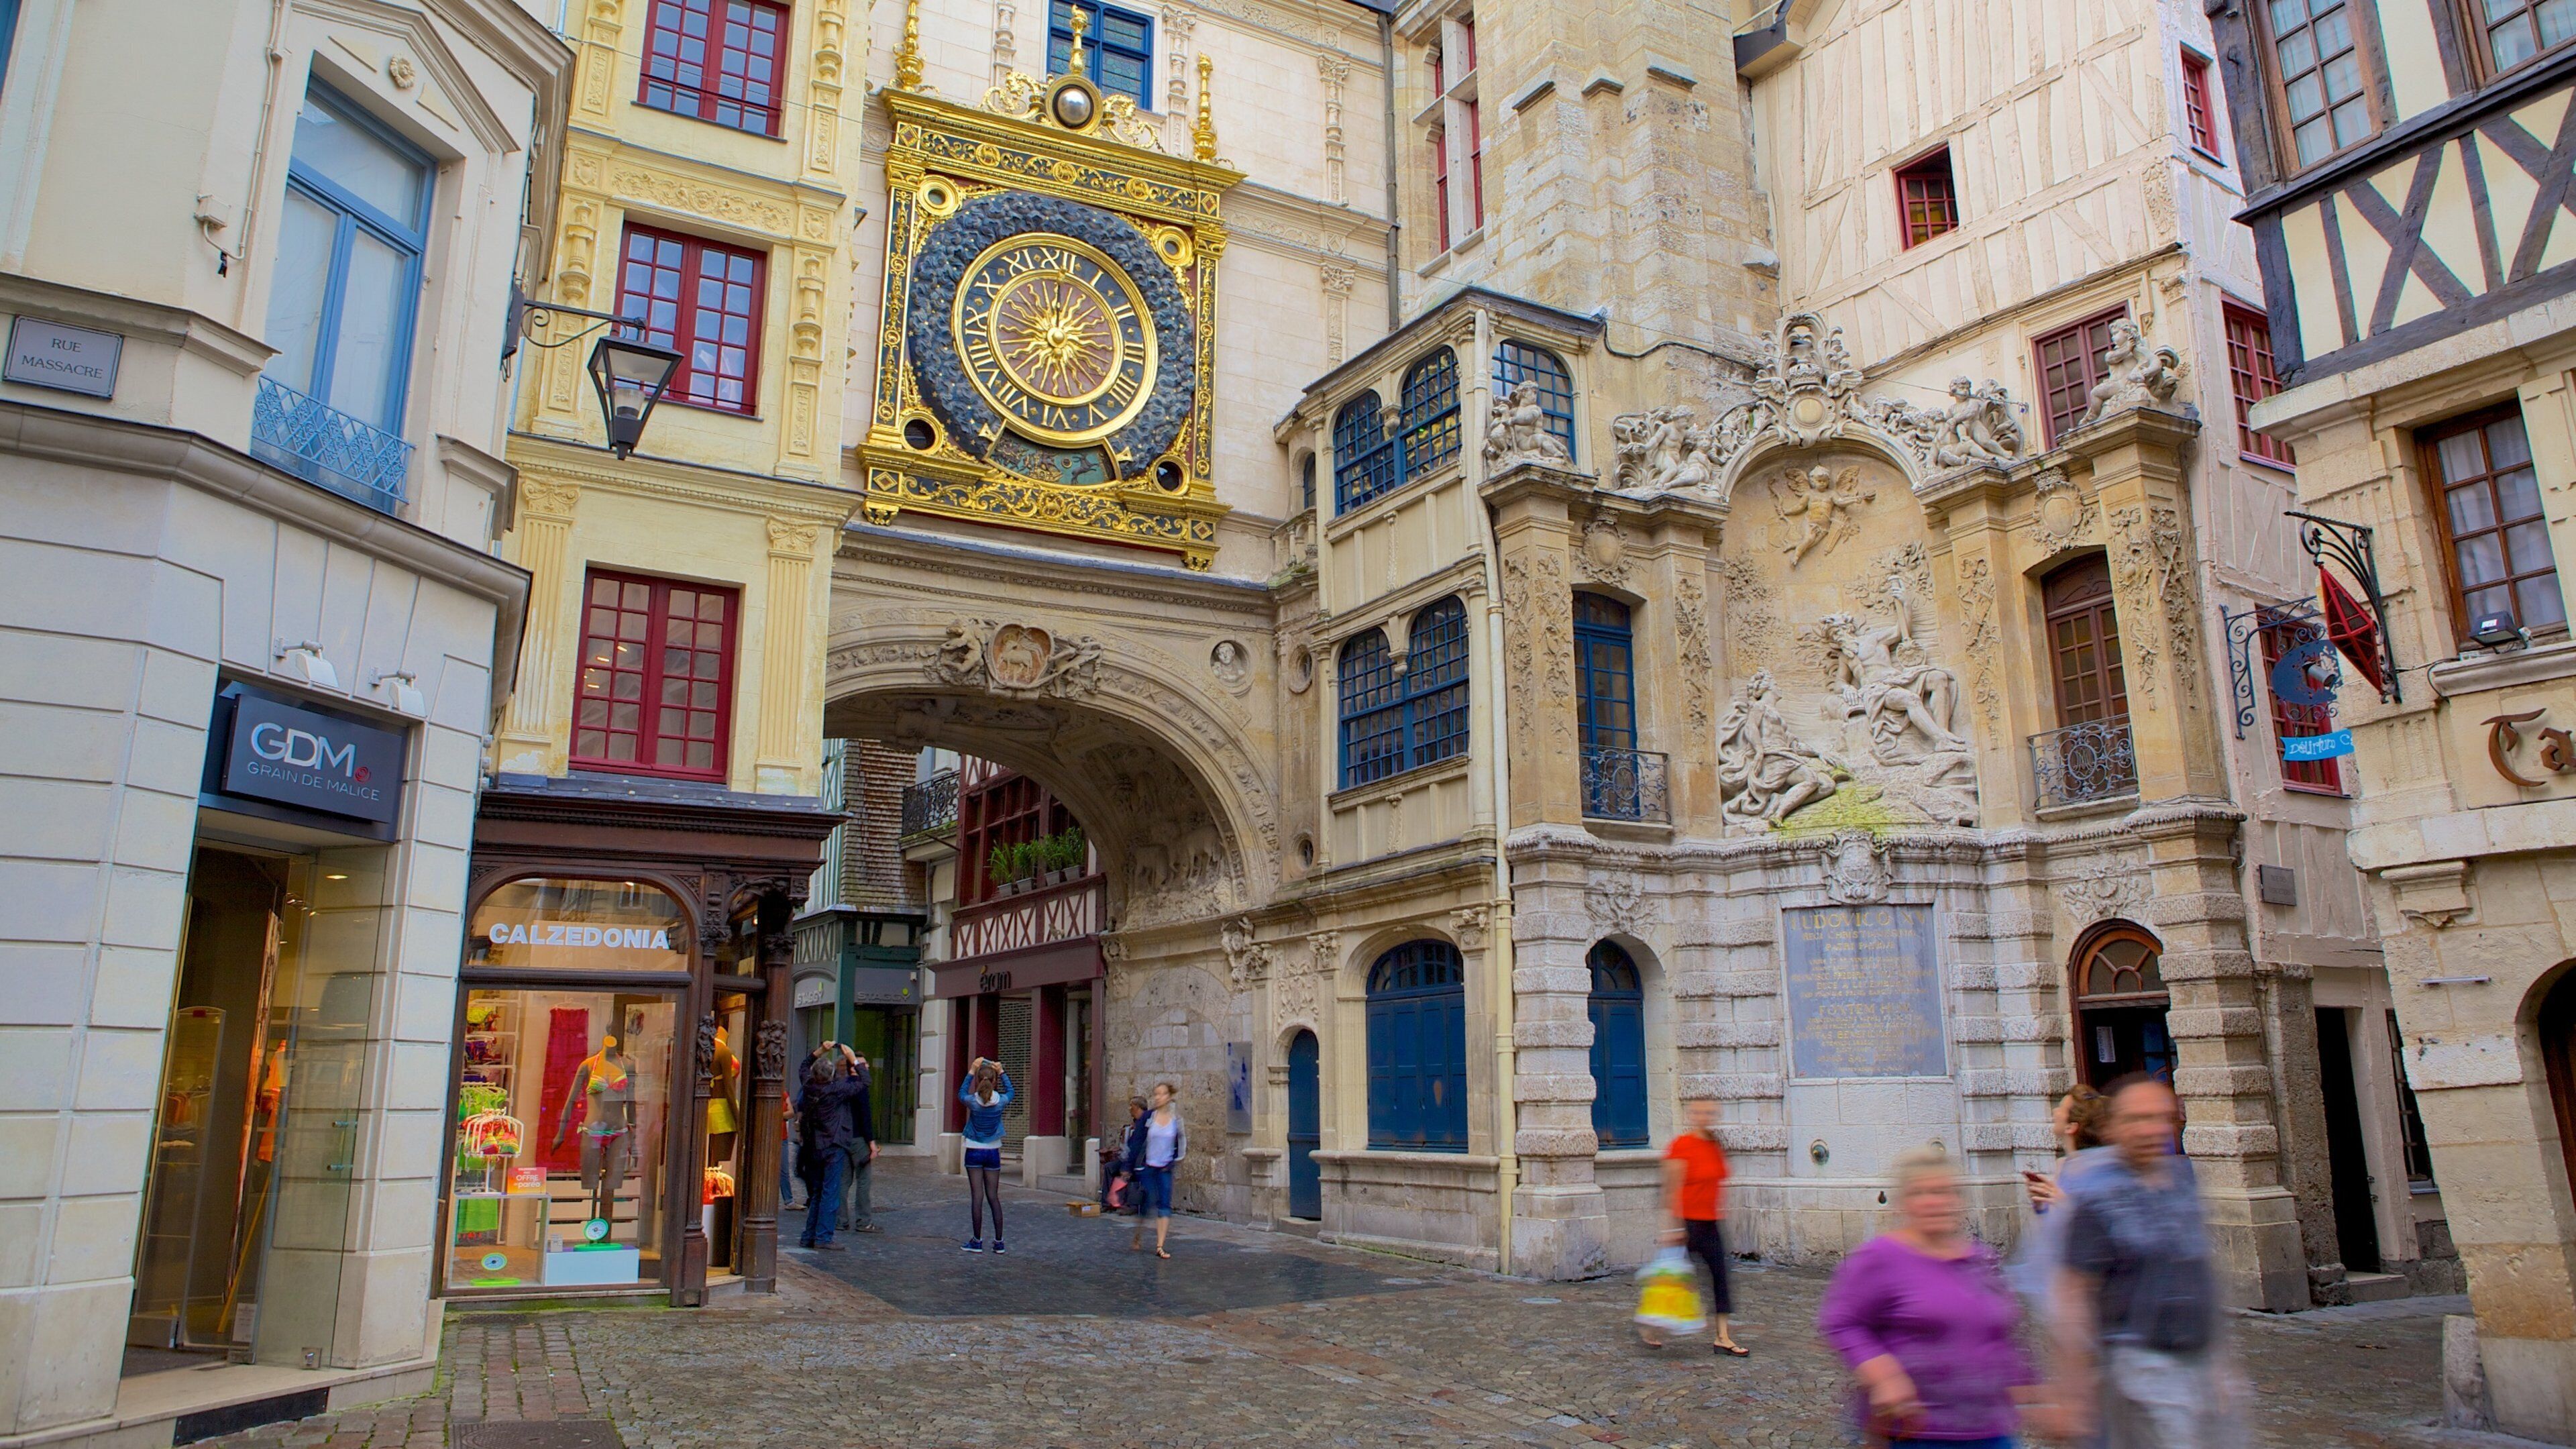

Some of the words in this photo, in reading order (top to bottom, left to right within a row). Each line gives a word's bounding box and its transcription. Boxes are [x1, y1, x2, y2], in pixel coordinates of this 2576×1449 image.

[51, 337, 82, 353] RUE
[21, 355, 103, 379] MASSACRE
[251, 722, 356, 777] GDM
[248, 761, 299, 784] GRAIN
[302, 773, 323, 788] DE
[327, 780, 380, 801] MALICE
[489, 923, 669, 949] CALZEDONIA
[979, 965, 1012, 992] éram
